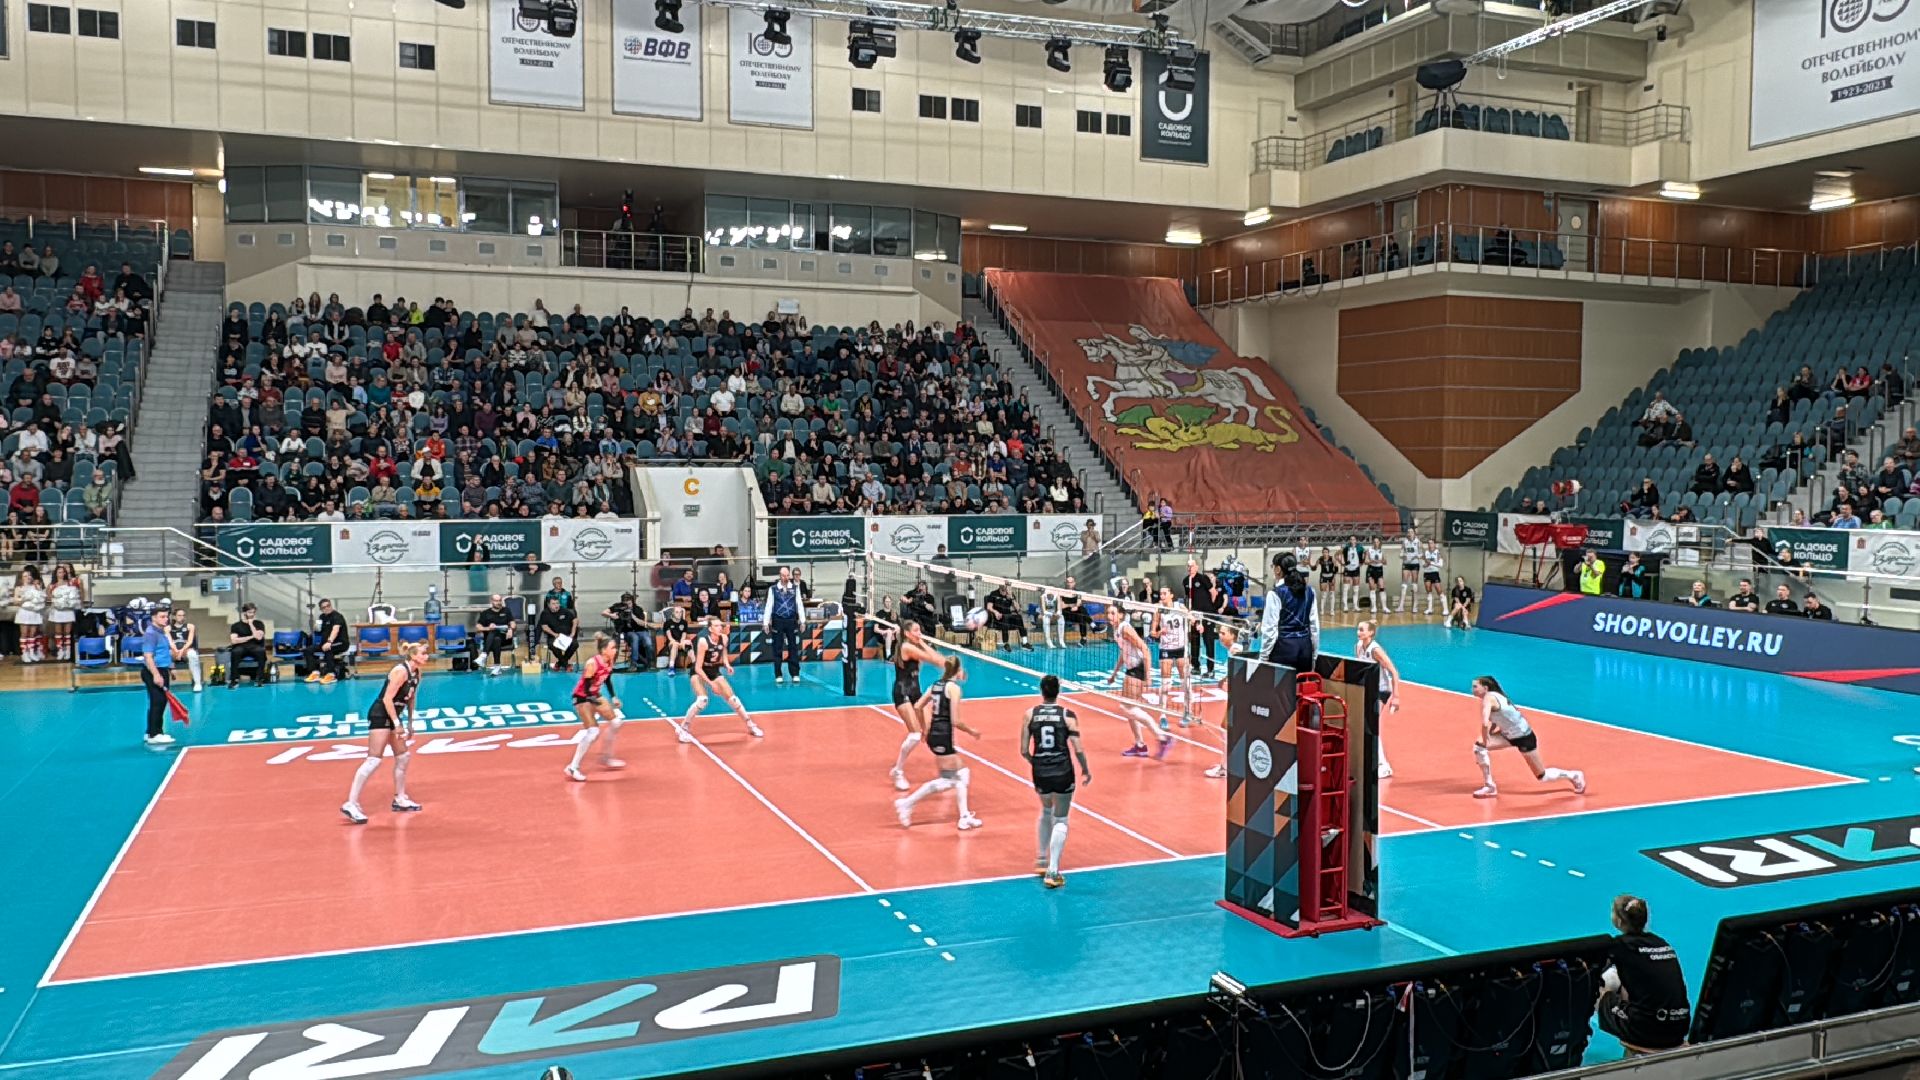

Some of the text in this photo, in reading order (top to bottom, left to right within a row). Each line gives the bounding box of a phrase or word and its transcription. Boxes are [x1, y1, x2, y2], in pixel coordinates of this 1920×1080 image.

[644, 37, 691, 59] ВФВ
[1801, 28, 1920, 70] ОТЕЧЕСТВЕННОМ
[1821, 51, 1906, 84] ВОЛЕЙБОЛУ
[1837, 79, 1886, 100] 1923-2023
[1158, 121, 1192, 133] САДОВОЕ
[1160, 130, 1191, 140] КОЛЬЦО
[809, 529, 850, 538] САДОВОЕ
[975, 526, 1015, 535] САДОВОЕ
[258, 537, 313, 547] САДОВОЕ
[809, 538, 846, 546] КОЛЬЦО
[975, 535, 1010, 543] КОЛЬЦО
[259, 547, 308, 556] КОЛЬЦО
[1793, 542, 1838, 553] САДОВОЕ
[1793, 551, 1833, 562] КОЛЬЦО
[1167, 618, 1180, 630] 13
[1592, 611, 1784, 656] SHOP.VOLLEY.RU
[710, 651, 719, 662] 2
[296, 702, 552, 726] ОБЛАТЬ
[227, 708, 626, 743] ОСКОВКАЯ
[1040, 725, 1055, 749] 6
[1659, 827, 1920, 883] ARI
[178, 961, 817, 1080] PARI
